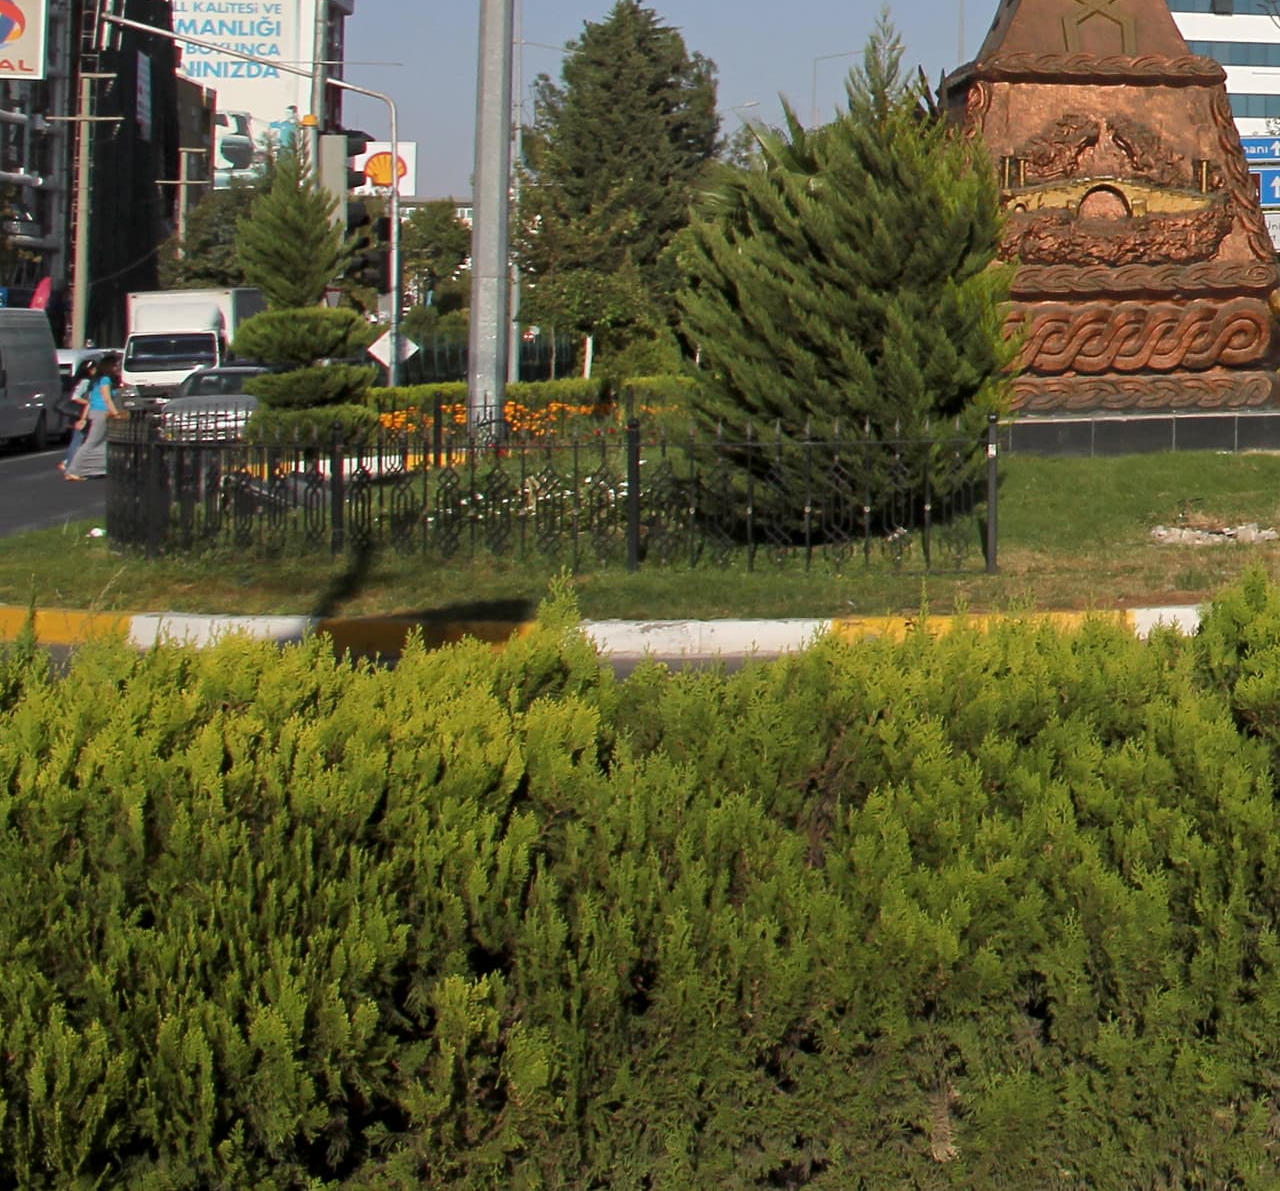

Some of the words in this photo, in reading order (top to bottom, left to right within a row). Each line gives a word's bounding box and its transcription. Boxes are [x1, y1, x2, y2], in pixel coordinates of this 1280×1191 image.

[262, 3, 282, 14] VE
[174, 16, 281, 37] MANLIĞI
[182, 61, 280, 78] NINIZDA
